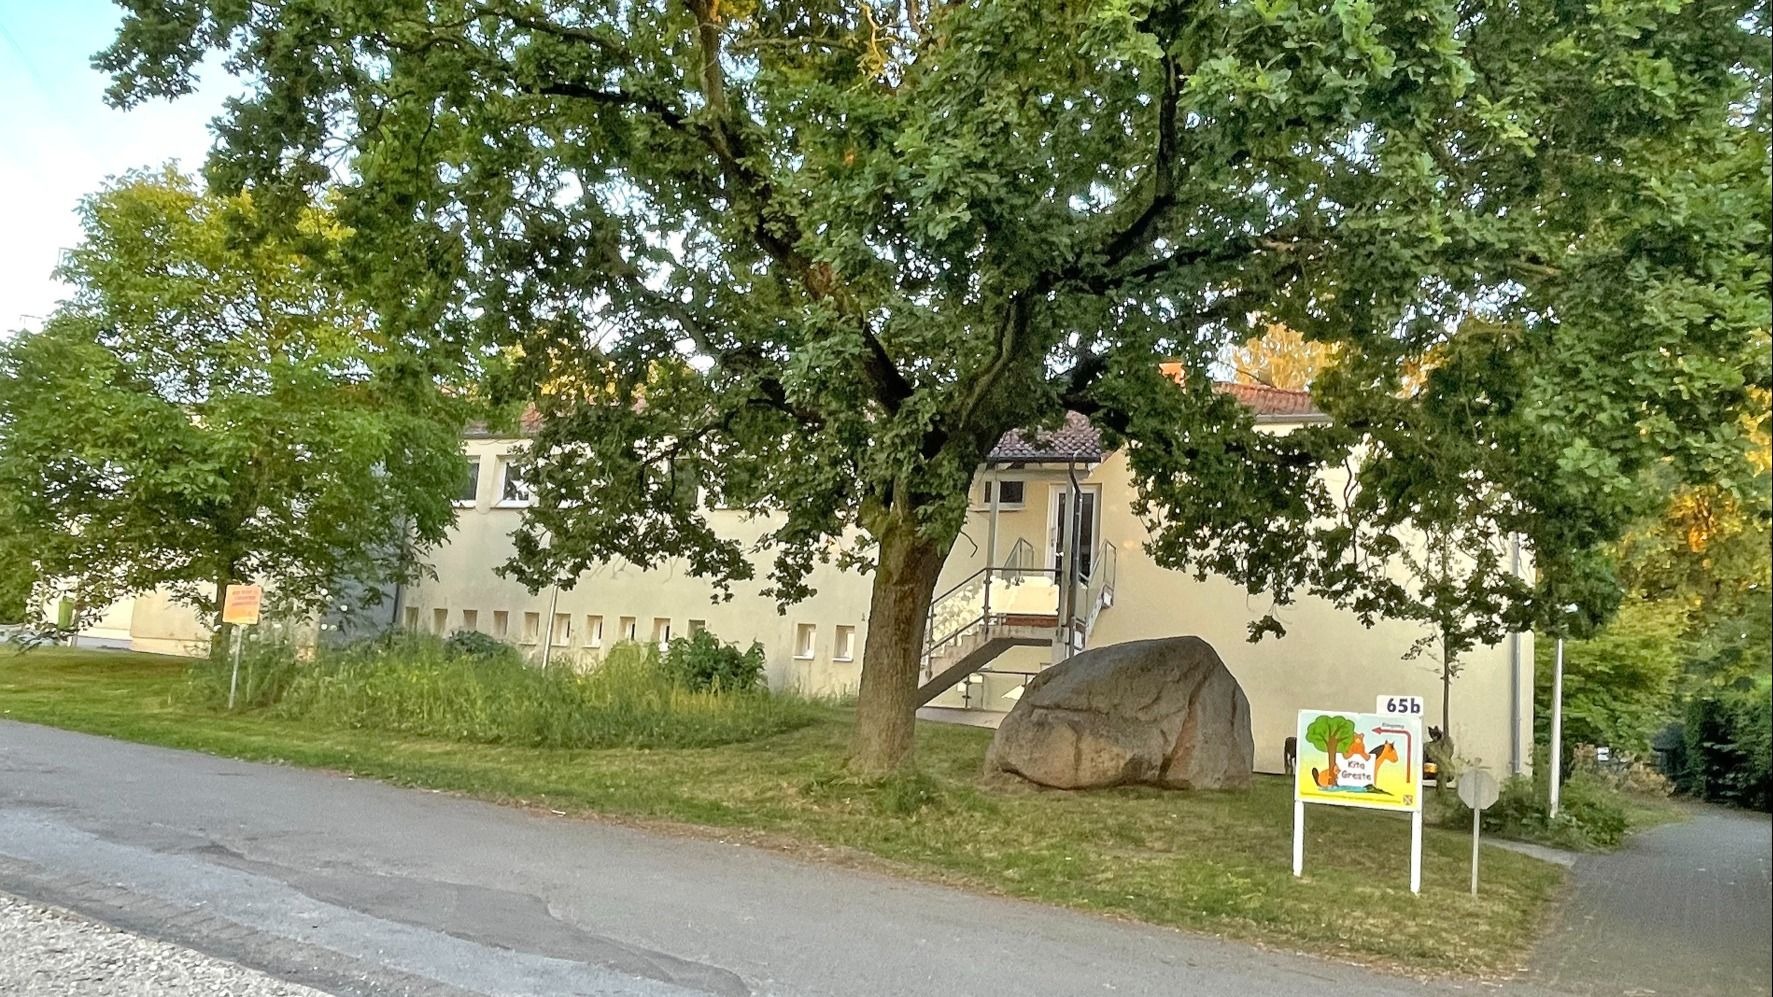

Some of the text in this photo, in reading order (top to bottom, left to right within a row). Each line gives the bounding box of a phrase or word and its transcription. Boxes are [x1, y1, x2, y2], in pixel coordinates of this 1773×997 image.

[1387, 698, 1420, 713] 65b
[1348, 760, 1365, 770] Kita
[1341, 770, 1371, 781] Greste
